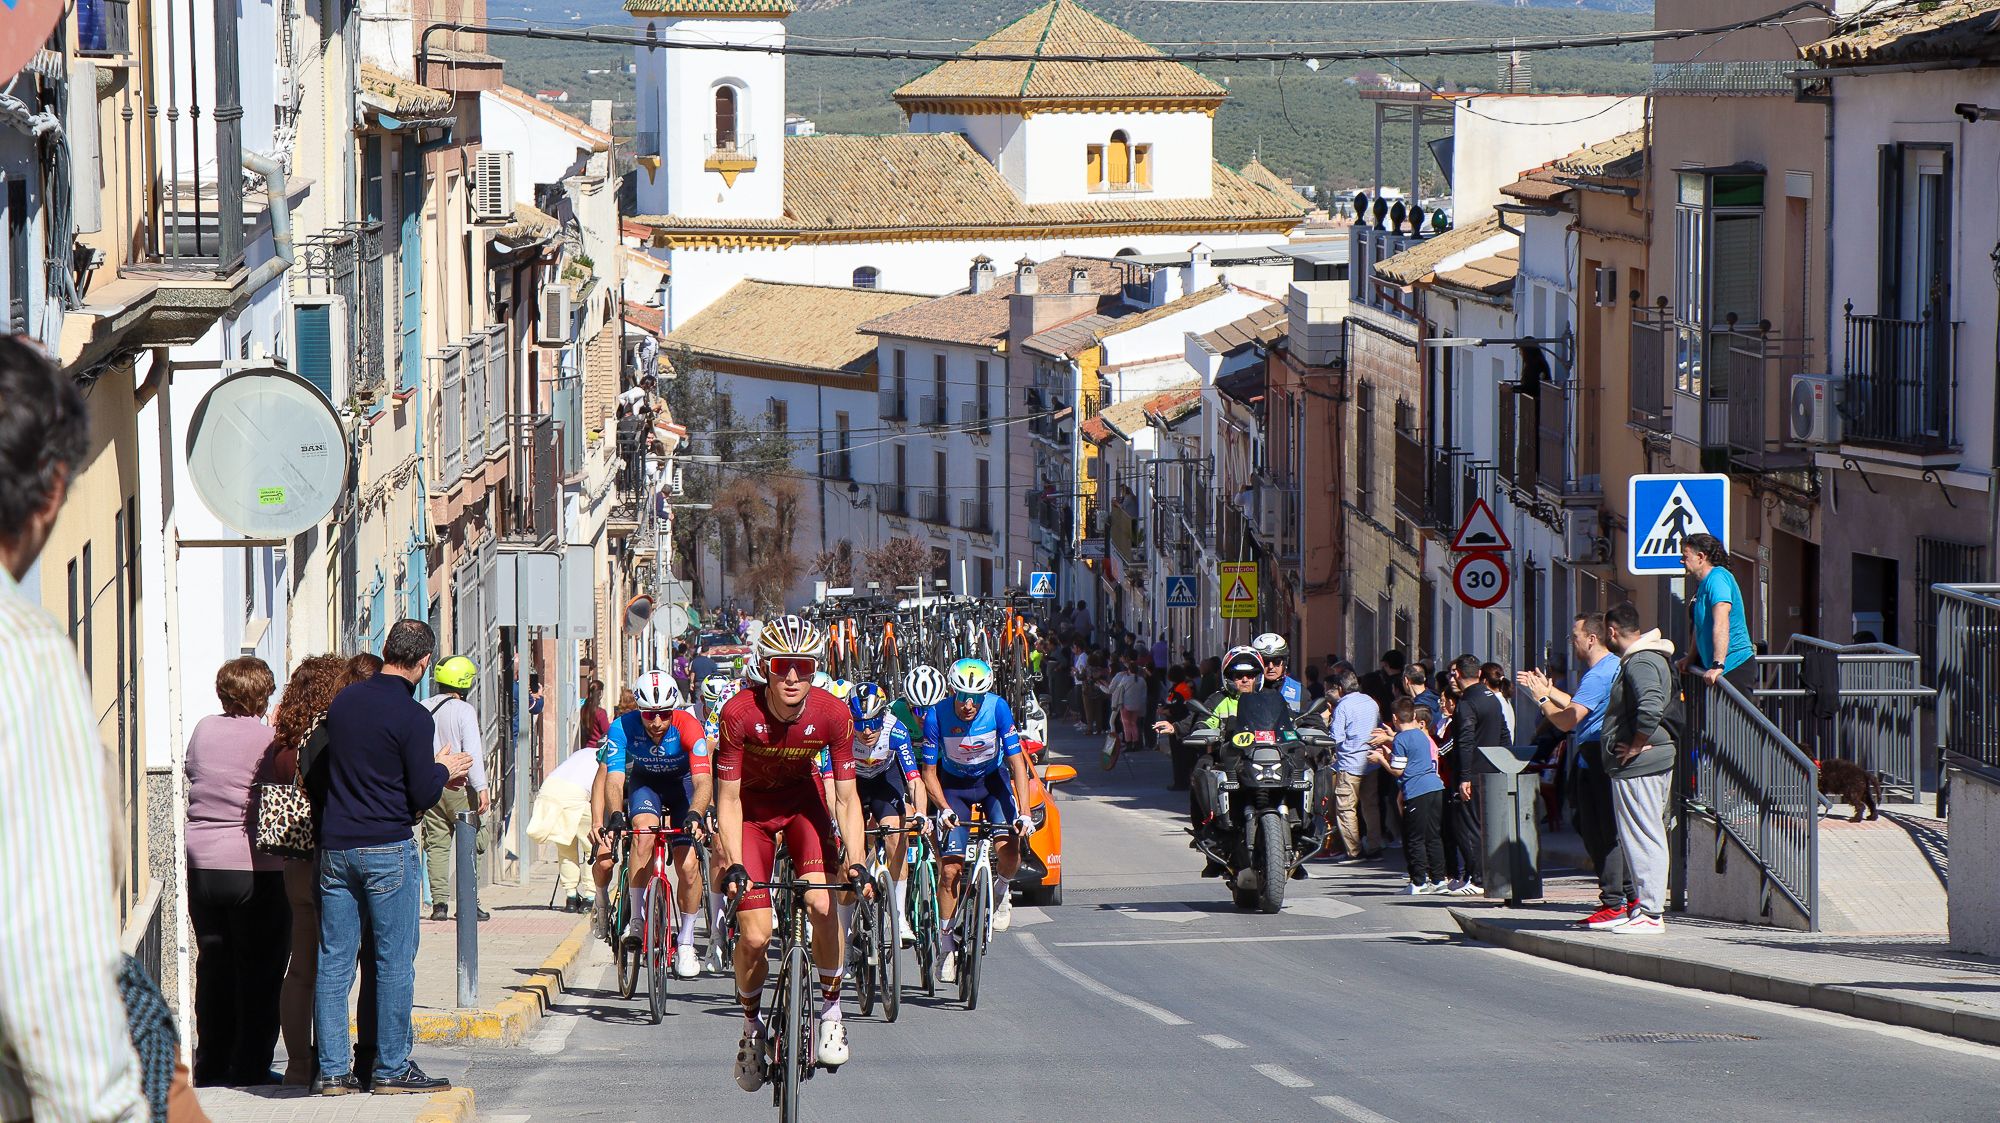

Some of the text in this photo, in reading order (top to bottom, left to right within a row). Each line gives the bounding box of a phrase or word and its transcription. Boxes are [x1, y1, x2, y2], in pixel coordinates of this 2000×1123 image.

[1466, 570, 1496, 588] 30
[892, 727, 907, 737] BORA
[1240, 734, 1251, 744] M
[899, 743, 914, 766] BOSS
[968, 848, 975, 859] S
